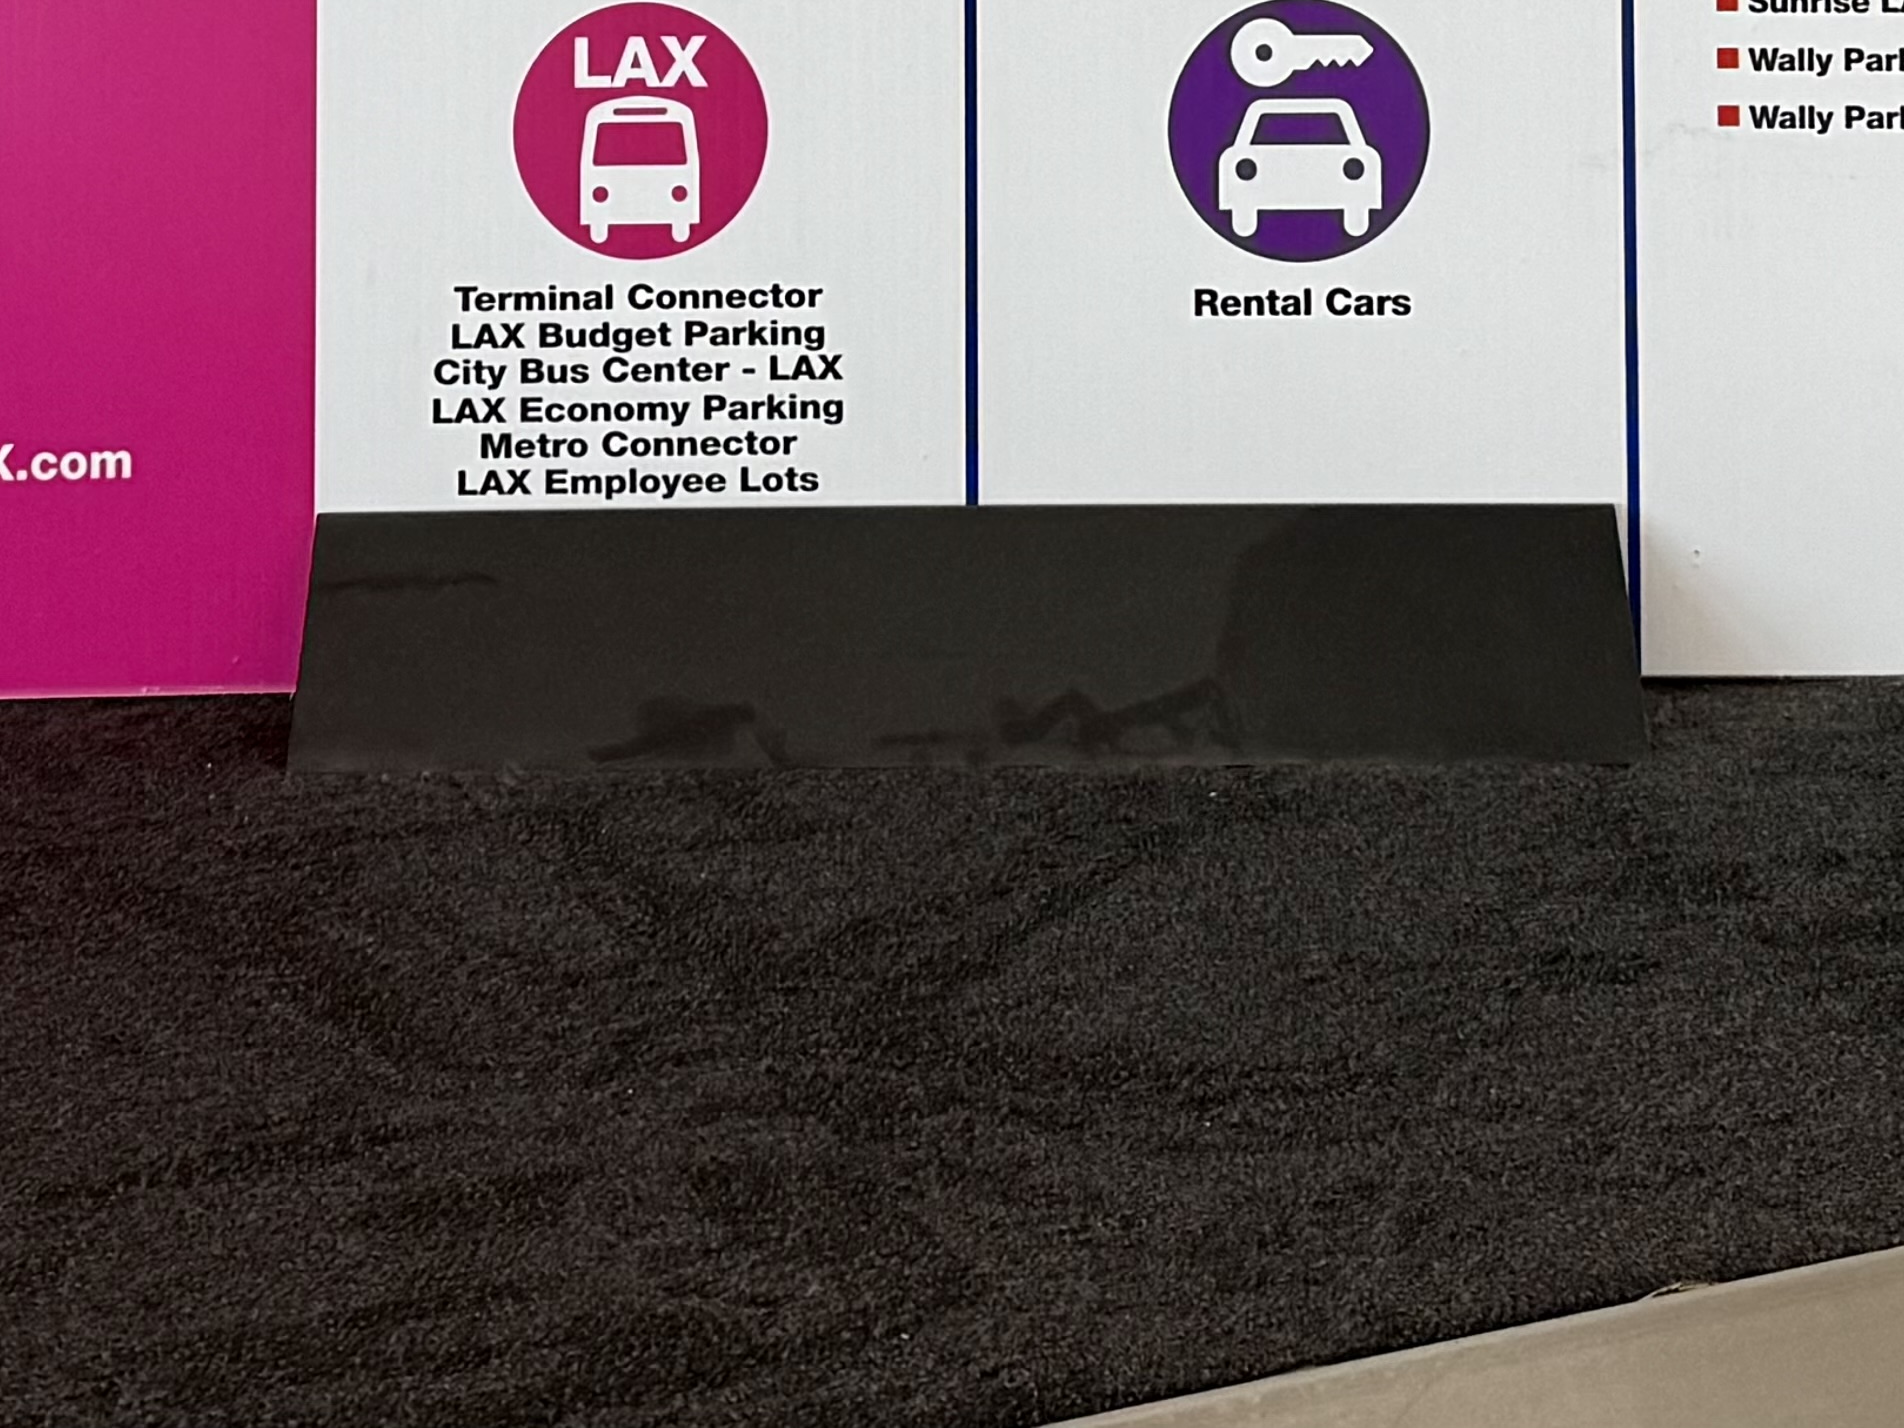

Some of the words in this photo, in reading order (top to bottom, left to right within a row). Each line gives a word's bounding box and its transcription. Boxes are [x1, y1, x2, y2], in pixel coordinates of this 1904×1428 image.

[575, 36, 709, 90] LAX
[1748, 48, 1834, 78] Wally
[1749, 105, 1835, 136] Wally
[454, 284, 615, 313] Terminal
[628, 284, 825, 312] Connector
[1195, 288, 1313, 318] Rental
[1326, 288, 1413, 318] Cars
[452, 323, 527, 351] LAX
[539, 322, 673, 355] Budget
[685, 320, 826, 353] Parking
[434, 359, 509, 390] City
[521, 358, 591, 386] Bus
[603, 357, 732, 385] Center
[770, 355, 845, 382] LAX
[433, 397, 508, 425] LAX
[521, 397, 692, 427] Economy
[704, 394, 845, 426] Parking
[481, 433, 590, 460] Metro
[602, 431, 799, 459] Connector
[458, 469, 533, 497] LAX
[546, 468, 728, 500] Employee
[741, 467, 820, 494] Lots
